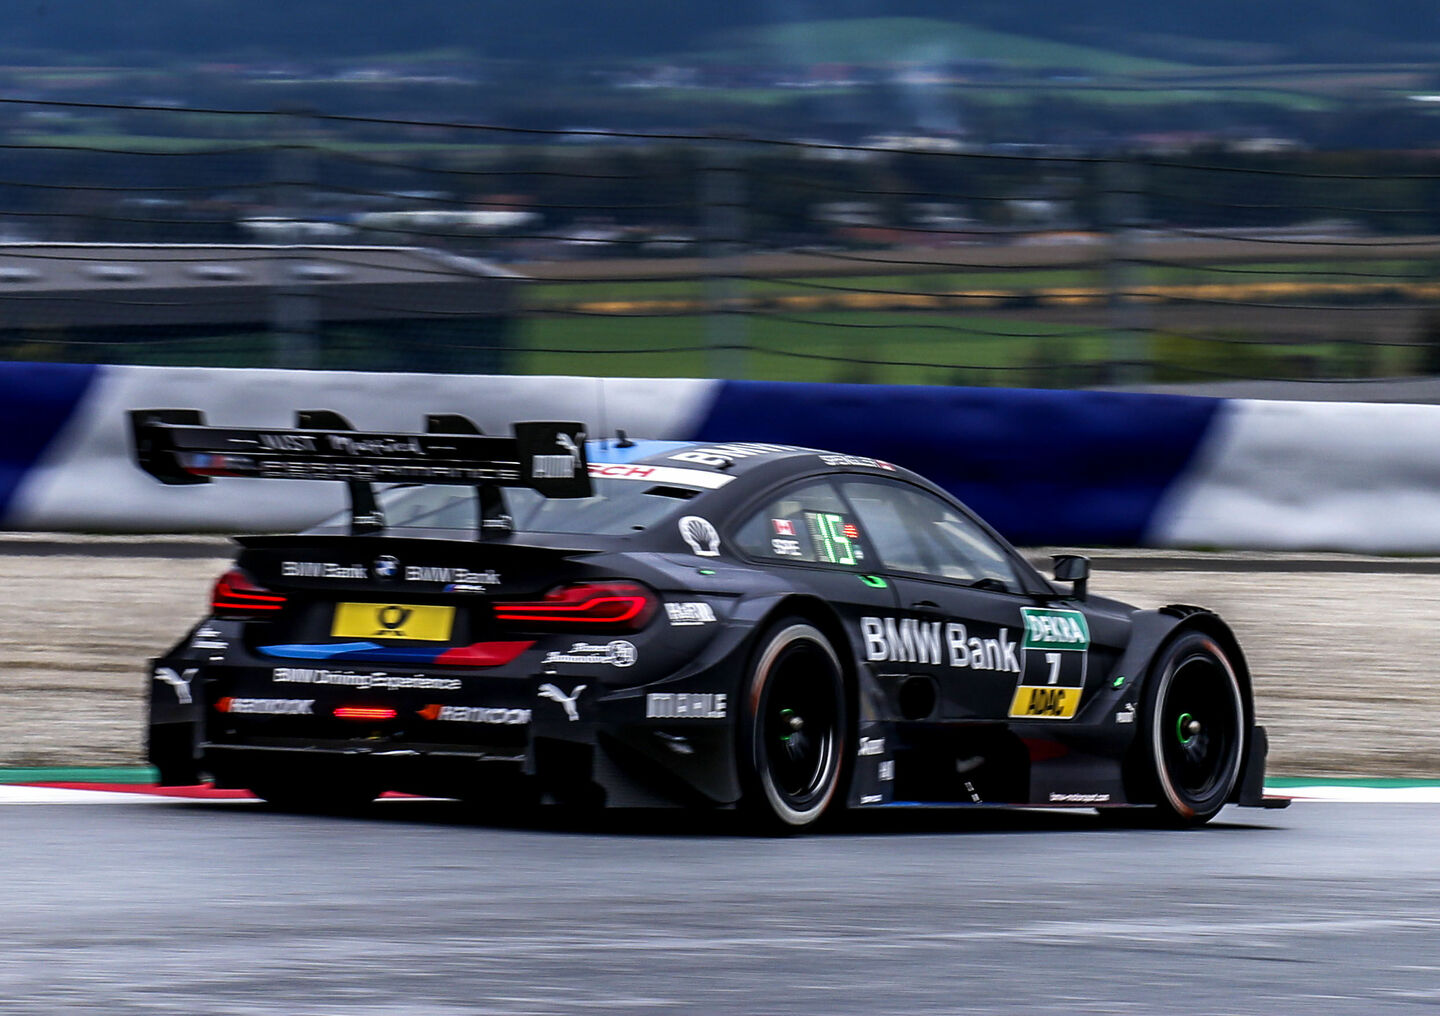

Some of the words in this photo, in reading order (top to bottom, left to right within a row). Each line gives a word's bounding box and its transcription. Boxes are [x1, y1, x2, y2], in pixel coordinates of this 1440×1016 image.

[815, 512, 858, 566] 15
[860, 616, 942, 665] BMW
[945, 622, 1022, 673] Bank
[1027, 614, 1086, 644] DEKRA
[1044, 652, 1062, 685] 7
[1025, 688, 1066, 716] ADAC
